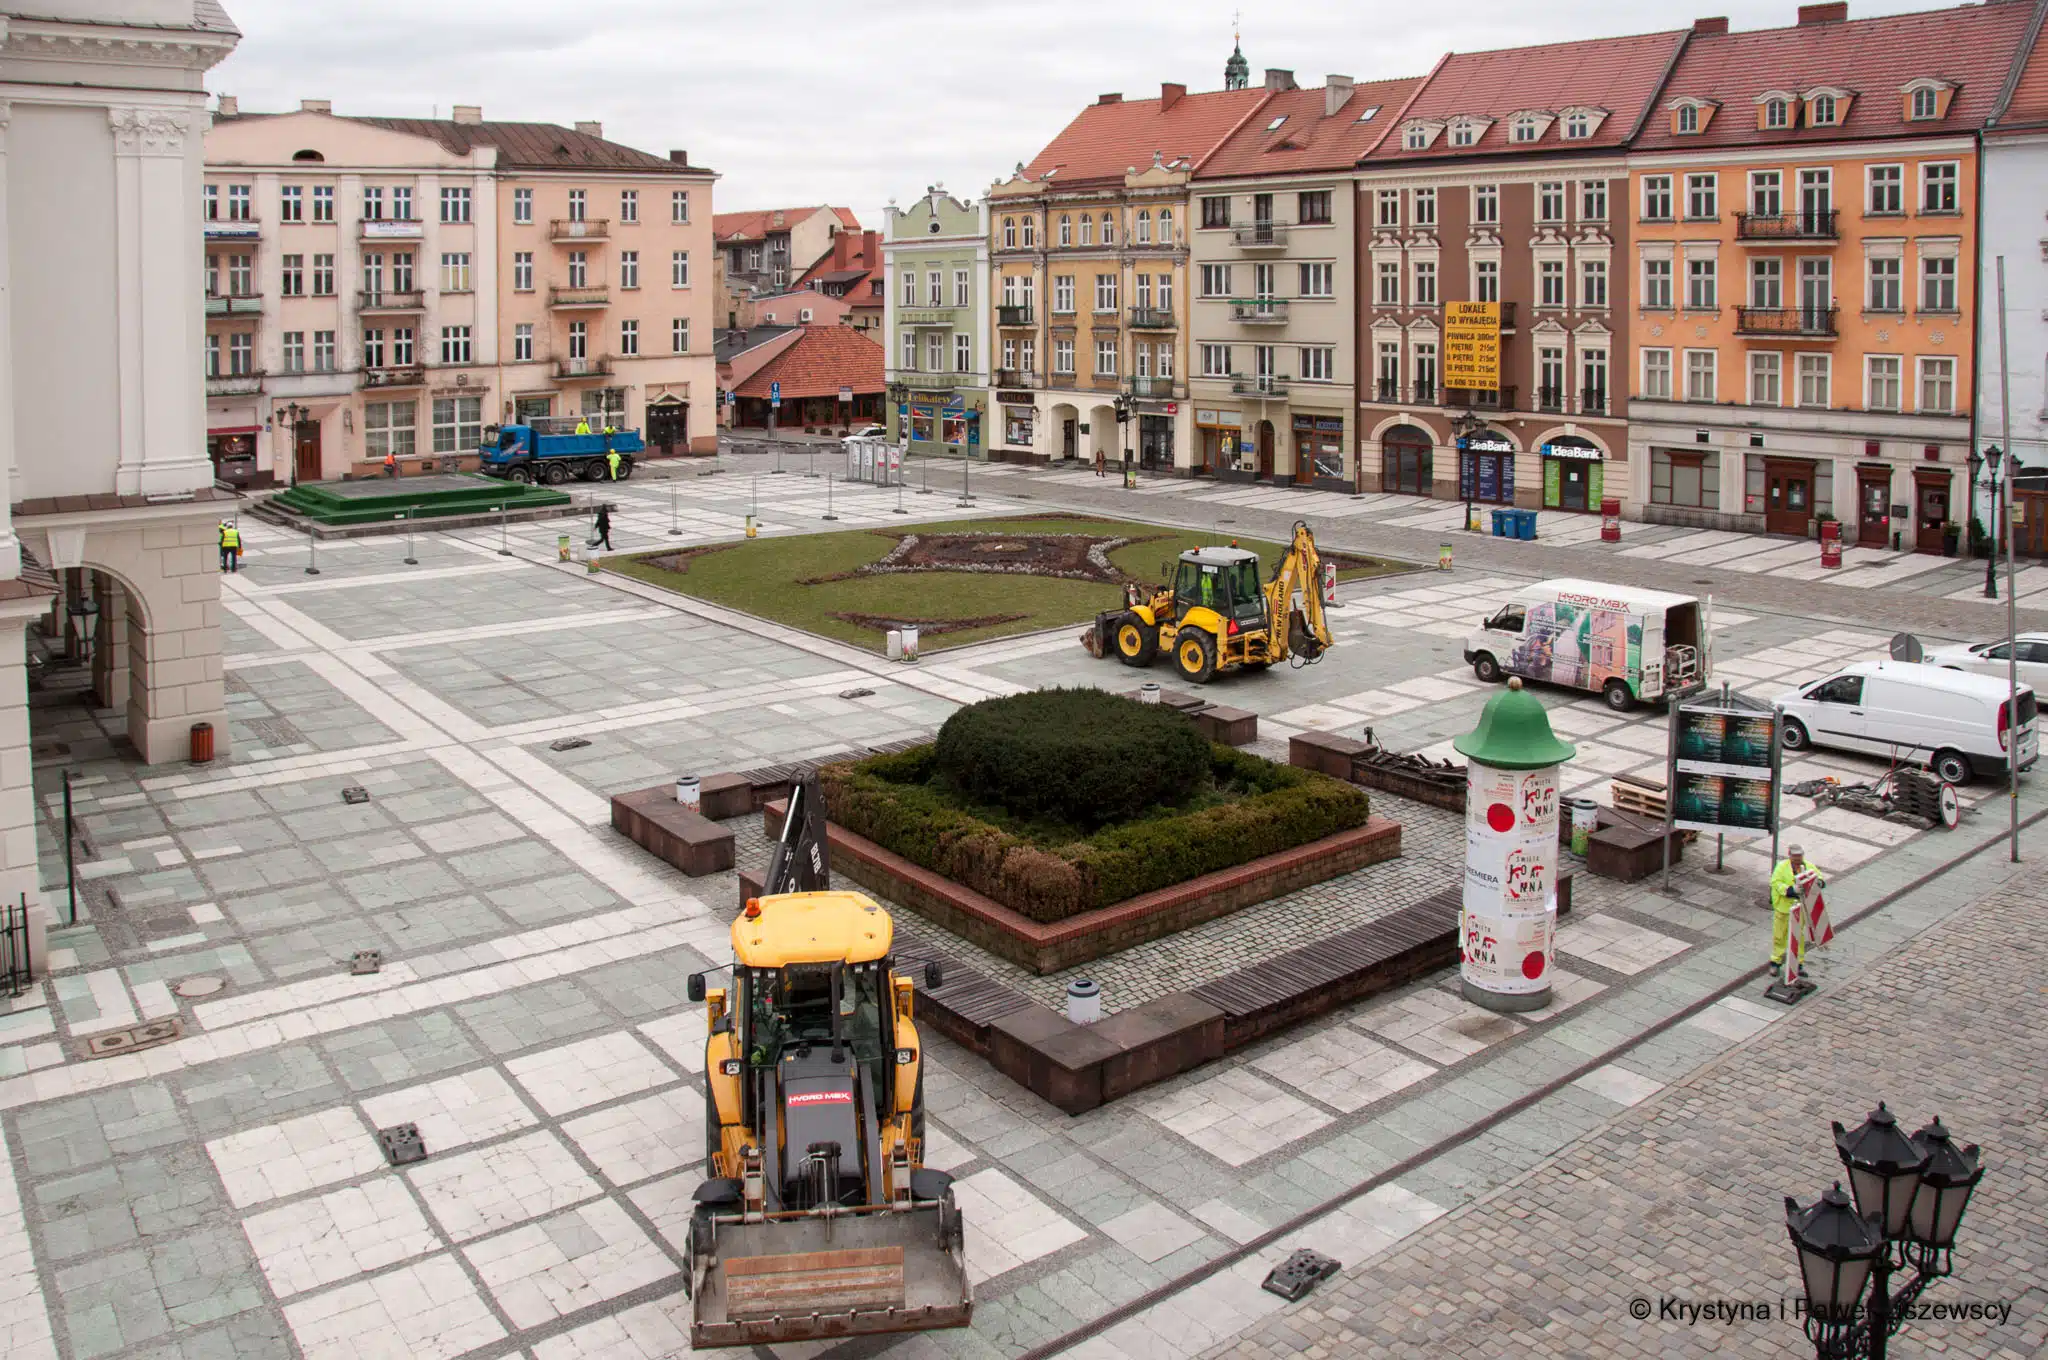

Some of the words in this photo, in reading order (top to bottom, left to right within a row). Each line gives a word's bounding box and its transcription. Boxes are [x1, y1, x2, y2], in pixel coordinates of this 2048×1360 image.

[1459, 304, 1487, 314] LOKALE
[1447, 316, 1456, 324] DO
[1447, 332, 1475, 340] PIWNICA
[1277, 581, 1285, 618] HOLLAND
[1557, 592, 1598, 605] HYDRO
[788, 1094, 824, 1105] HYDRO
